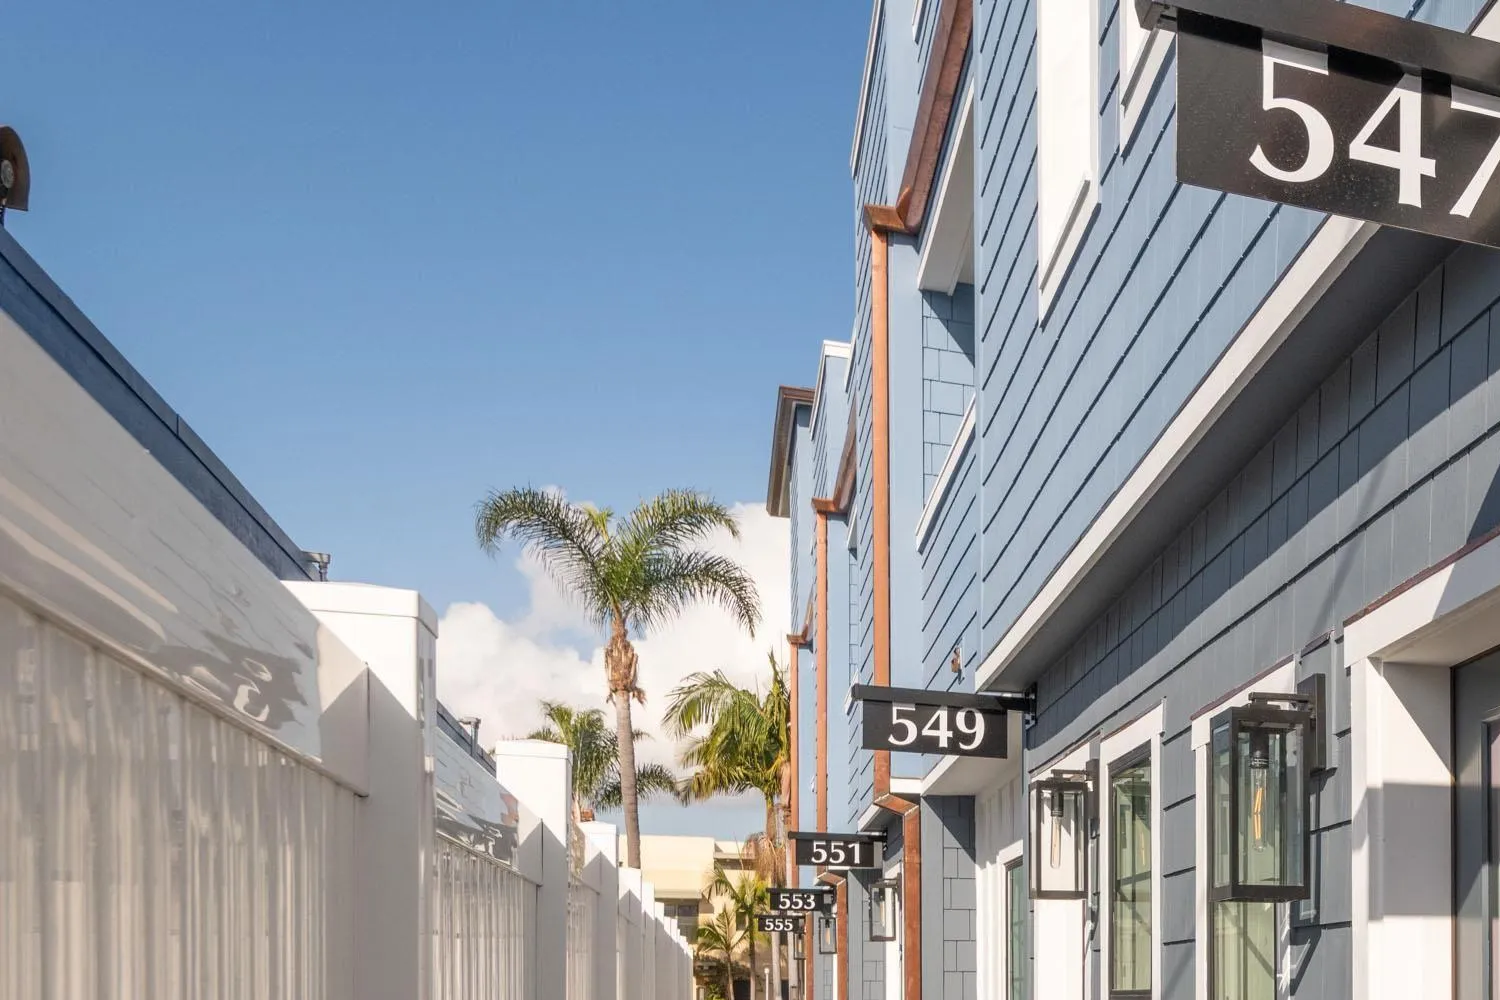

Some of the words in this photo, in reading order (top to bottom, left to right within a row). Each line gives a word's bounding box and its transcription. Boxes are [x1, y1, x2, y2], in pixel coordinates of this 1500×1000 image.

[887, 702, 986, 751] 549
[810, 841, 861, 865] 551
[778, 893, 816, 910] 553
[764, 918, 794, 932] 555
